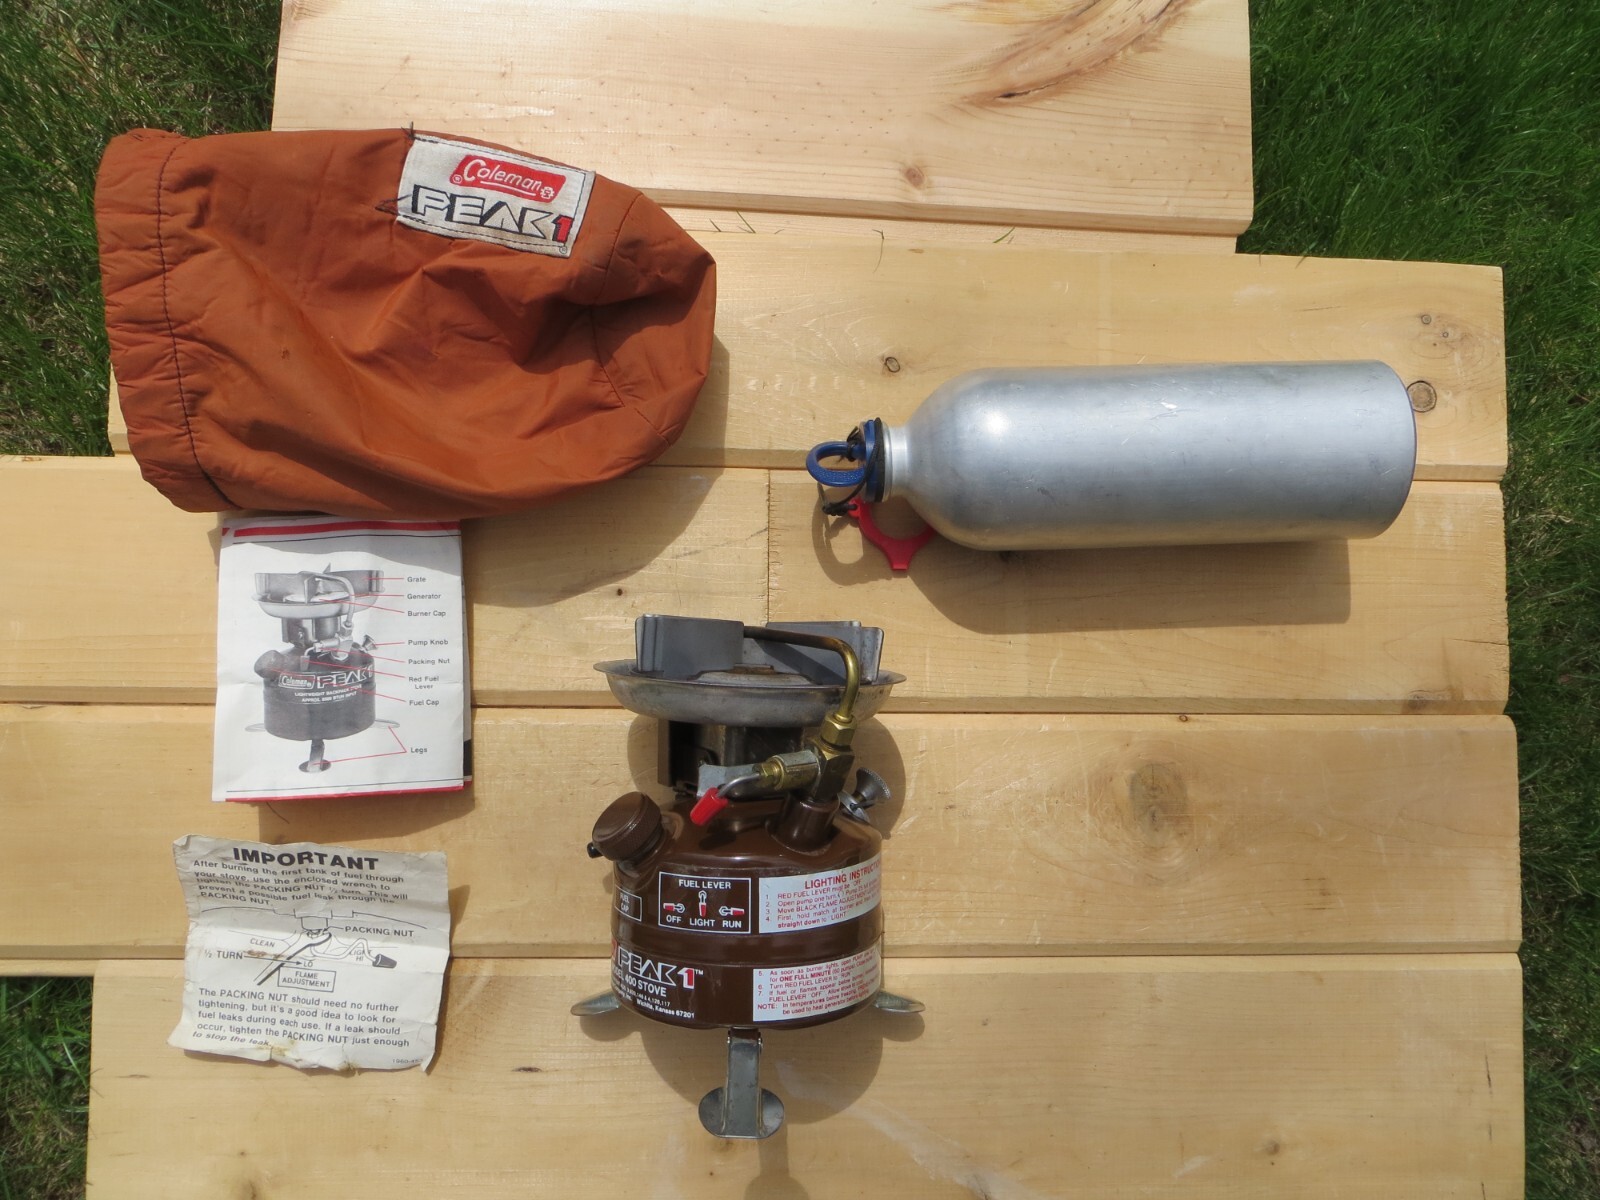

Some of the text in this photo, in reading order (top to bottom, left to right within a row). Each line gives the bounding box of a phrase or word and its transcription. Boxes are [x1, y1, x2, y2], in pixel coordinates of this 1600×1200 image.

[463, 159, 541, 191] Coleman
[432, 610, 446, 618] Cap
[426, 699, 440, 707] Cap
[233, 848, 379, 870] IMPORTANT
[194, 860, 218, 868] After
[222, 862, 258, 874] burning
[262, 868, 278, 876] the
[366, 875, 404, 884] through
[220, 872, 250, 882] stove,
[294, 876, 338, 886] enclosed
[341, 880, 377, 890] wrench
[678, 880, 732, 890] FUEL LEVER
[804, 874, 847, 890] LIGHTING
[254, 884, 300, 892] PACKING
[812, 887, 830, 896] LEVER
[200, 892, 246, 902] PACKING
[248, 890, 288, 901] possible
[314, 892, 334, 900] leak
[338, 894, 376, 902] through
[620, 894, 630, 904] FUEL
[620, 904, 630, 912] CAP
[796, 904, 817, 912] BLACK
[819, 900, 838, 908] FLAME
[813, 909, 830, 917] match
[666, 914, 742, 928] OFF LIGHT RUN
[778, 920, 802, 928] straight
[344, 926, 414, 938] PACKING NUT
[250, 938, 275, 948] CLEAN
[217, 950, 243, 960] TURN
[295, 971, 318, 979] FLAME
[810, 970, 830, 978] MINUTE
[282, 978, 331, 988] ADJUSTMENT
[814, 976, 832, 984] LEVER
[624, 974, 636, 987] 400
[638, 980, 667, 998] STOVE
[199, 988, 216, 997] The
[220, 989, 264, 1000] PACKING
[268, 993, 288, 1002] NUT
[292, 996, 320, 1006] should
[324, 1000, 347, 1008] need
[366, 1003, 399, 1012] further
[790, 998, 825, 1008] temperatures
[198, 1000, 248, 1012] tightening,
[252, 1004, 267, 1012] but
[270, 1004, 284, 1013] it's
[295, 1008, 318, 1017] good
[321, 1010, 340, 1020] idea
[358, 1014, 378, 1023] look
[382, 1015, 396, 1024] for
[655, 1004, 675, 1016] Kansas
[676, 1010, 695, 1018] 67201
[198, 1010, 216, 1019] fuel
[218, 1012, 242, 1022] leaks
[246, 1015, 276, 1026] during
[280, 1019, 298, 1028] each
[301, 1022, 320, 1030] use.
[344, 1025, 364, 1033] leak
[368, 1026, 400, 1036] should
[197, 1024, 410, 1048] occur, tighten the PACKING NUT just enough
[206, 1033, 227, 1041] stop
[249, 1038, 272, 1047] leak.
